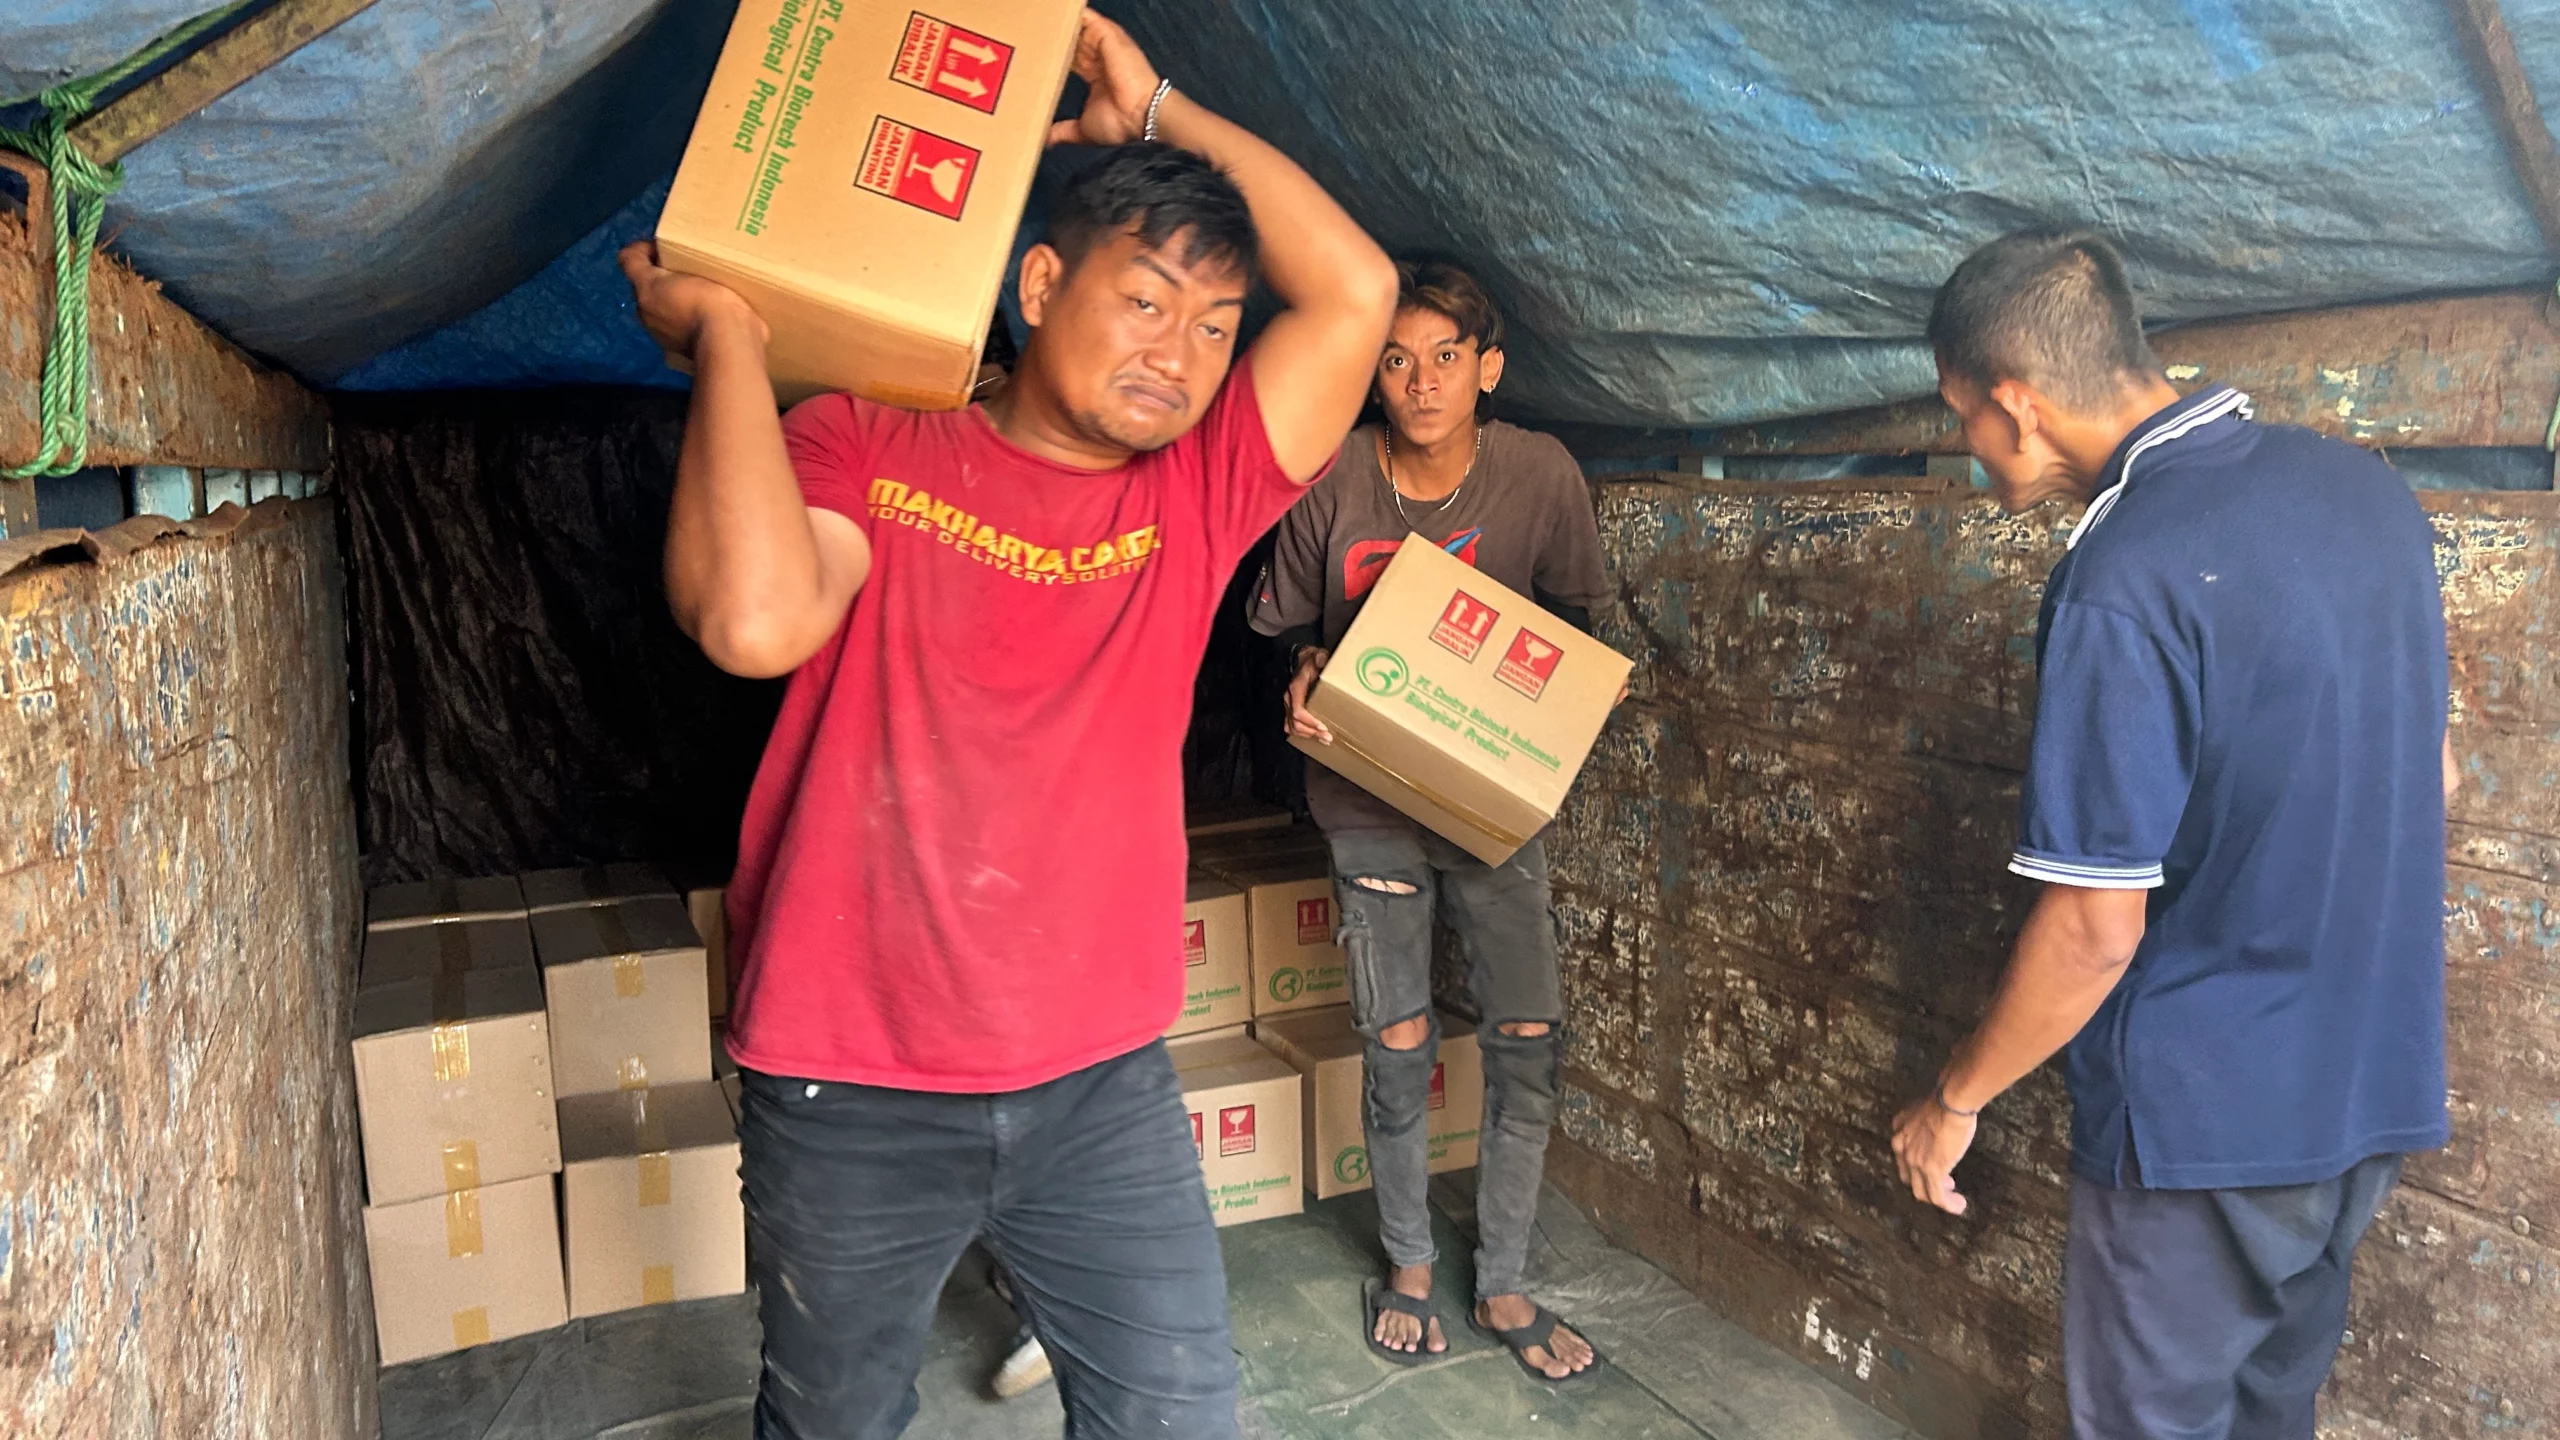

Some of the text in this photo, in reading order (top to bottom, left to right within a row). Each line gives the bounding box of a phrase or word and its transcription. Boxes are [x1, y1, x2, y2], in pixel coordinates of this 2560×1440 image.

[799, 26, 834, 82] Centra
[895, 17, 925, 76] DIBALIK
[911, 22, 940, 83] JANGAN
[733, 78, 777, 153] Product
[775, 85, 813, 149] Biotech
[863, 122, 891, 184] DIBANTING
[875, 126, 905, 190] JANGAN
[745, 152, 790, 236] Indonesia
[867, 478, 1067, 574] MAKHARYA
[868, 505, 932, 533] YOUR
[937, 530, 1058, 585] DELIVERY
[1184, 1004, 1211, 1017] roduct
